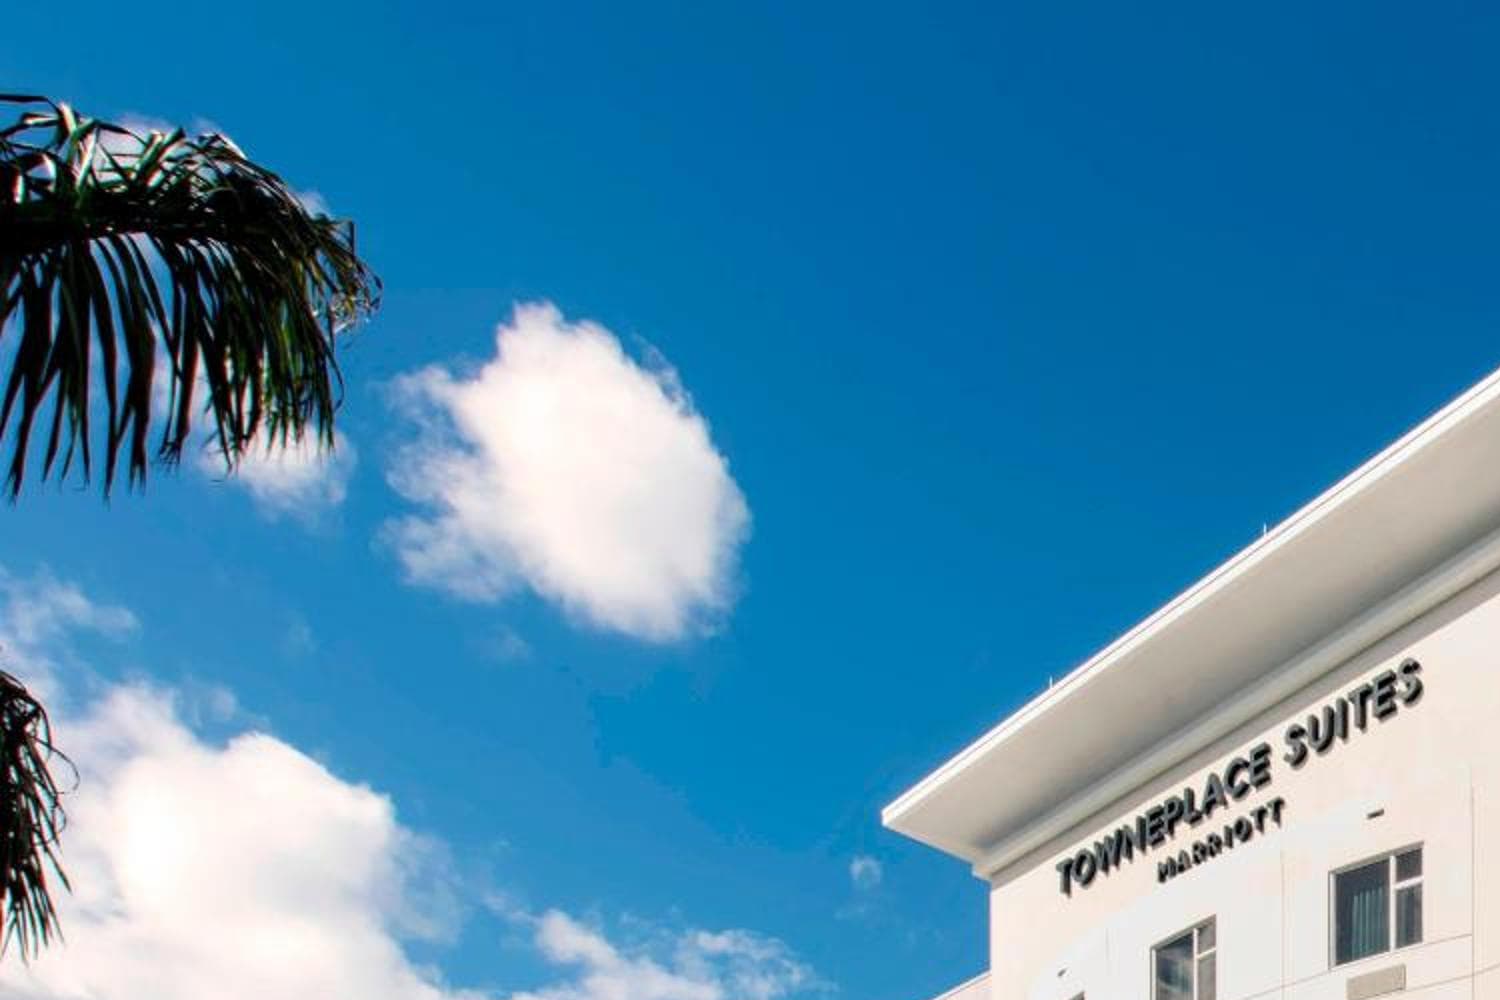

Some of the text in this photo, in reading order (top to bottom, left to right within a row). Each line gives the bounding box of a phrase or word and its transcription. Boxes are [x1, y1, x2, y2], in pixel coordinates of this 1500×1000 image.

[1055, 656, 1424, 898] TOWNEPLACE SUITES
[1157, 796, 1286, 884] MARRIOTT
